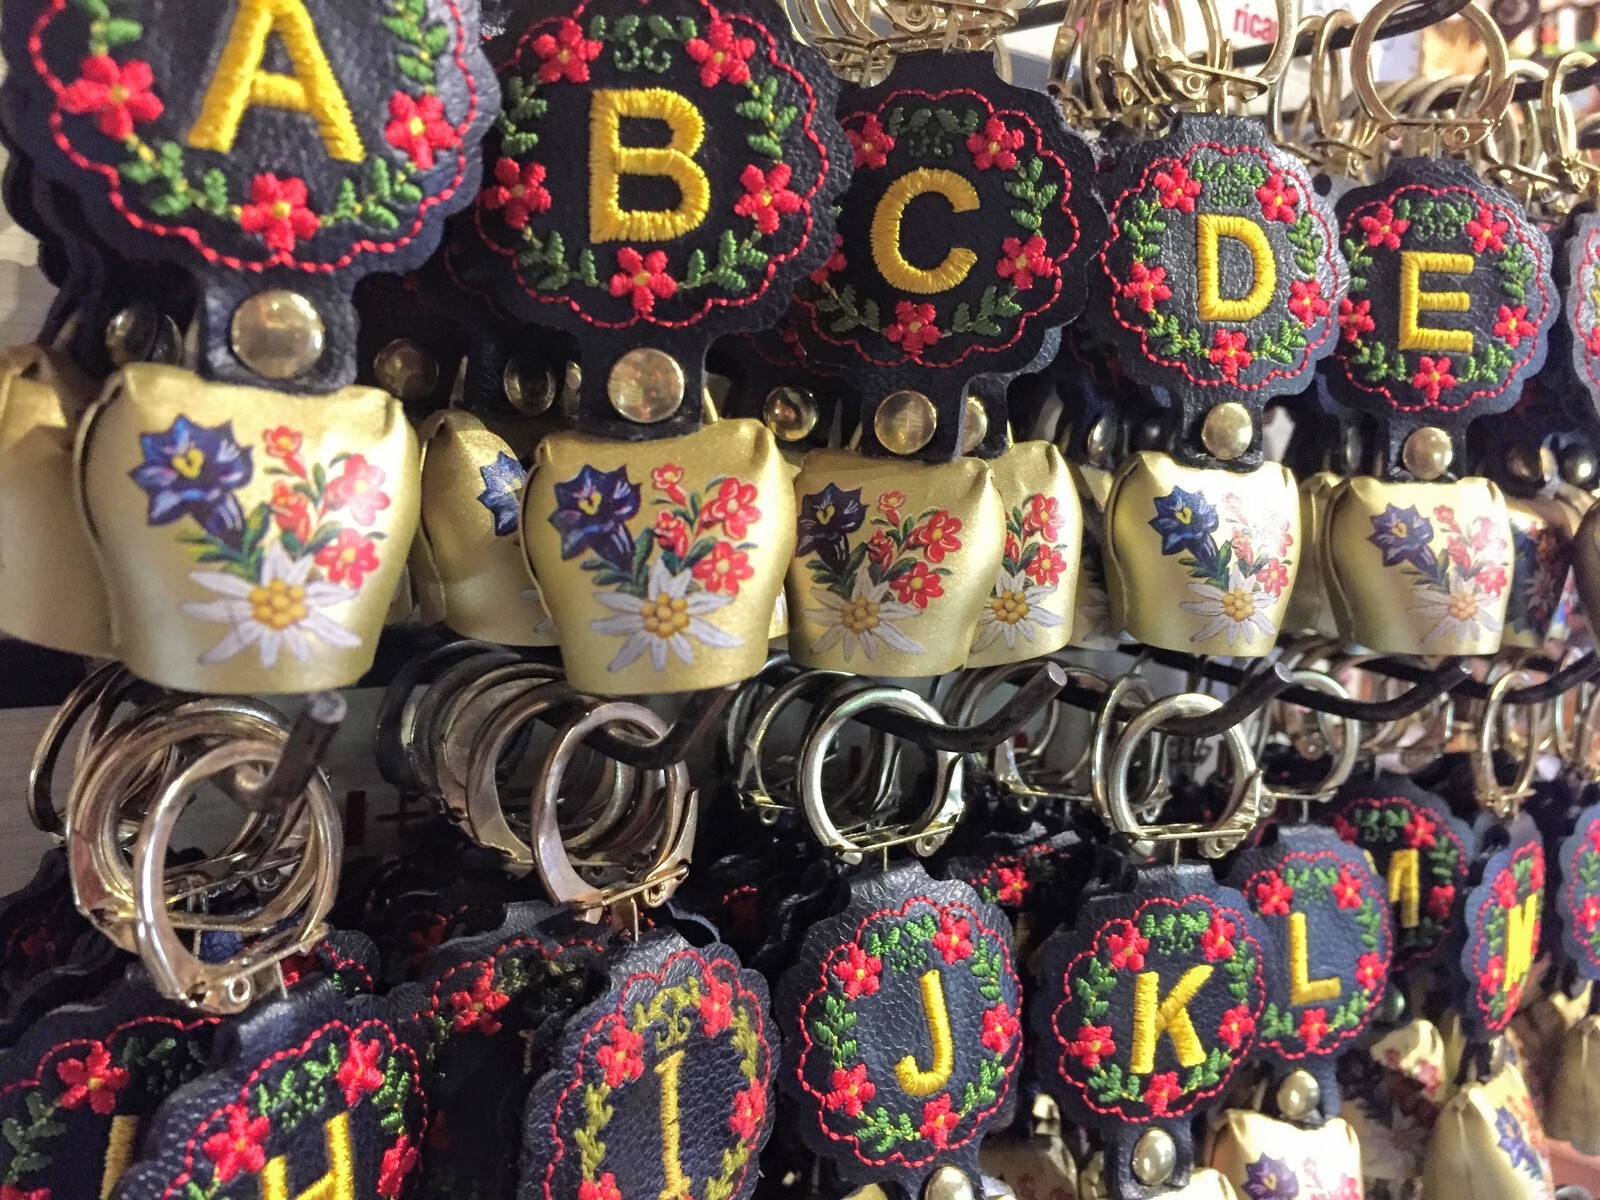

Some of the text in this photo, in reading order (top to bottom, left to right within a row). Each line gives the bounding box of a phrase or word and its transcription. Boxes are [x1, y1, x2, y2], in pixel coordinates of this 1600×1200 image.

[187, 0, 366, 163] A
[589, 87, 711, 244] B
[870, 167, 980, 294] C
[1197, 212, 1277, 321] D
[1398, 250, 1474, 353] E
[1129, 964, 1214, 1075] K
[1288, 912, 1341, 1005] L
[894, 968, 954, 1096] J
[653, 1050, 692, 1200] I
